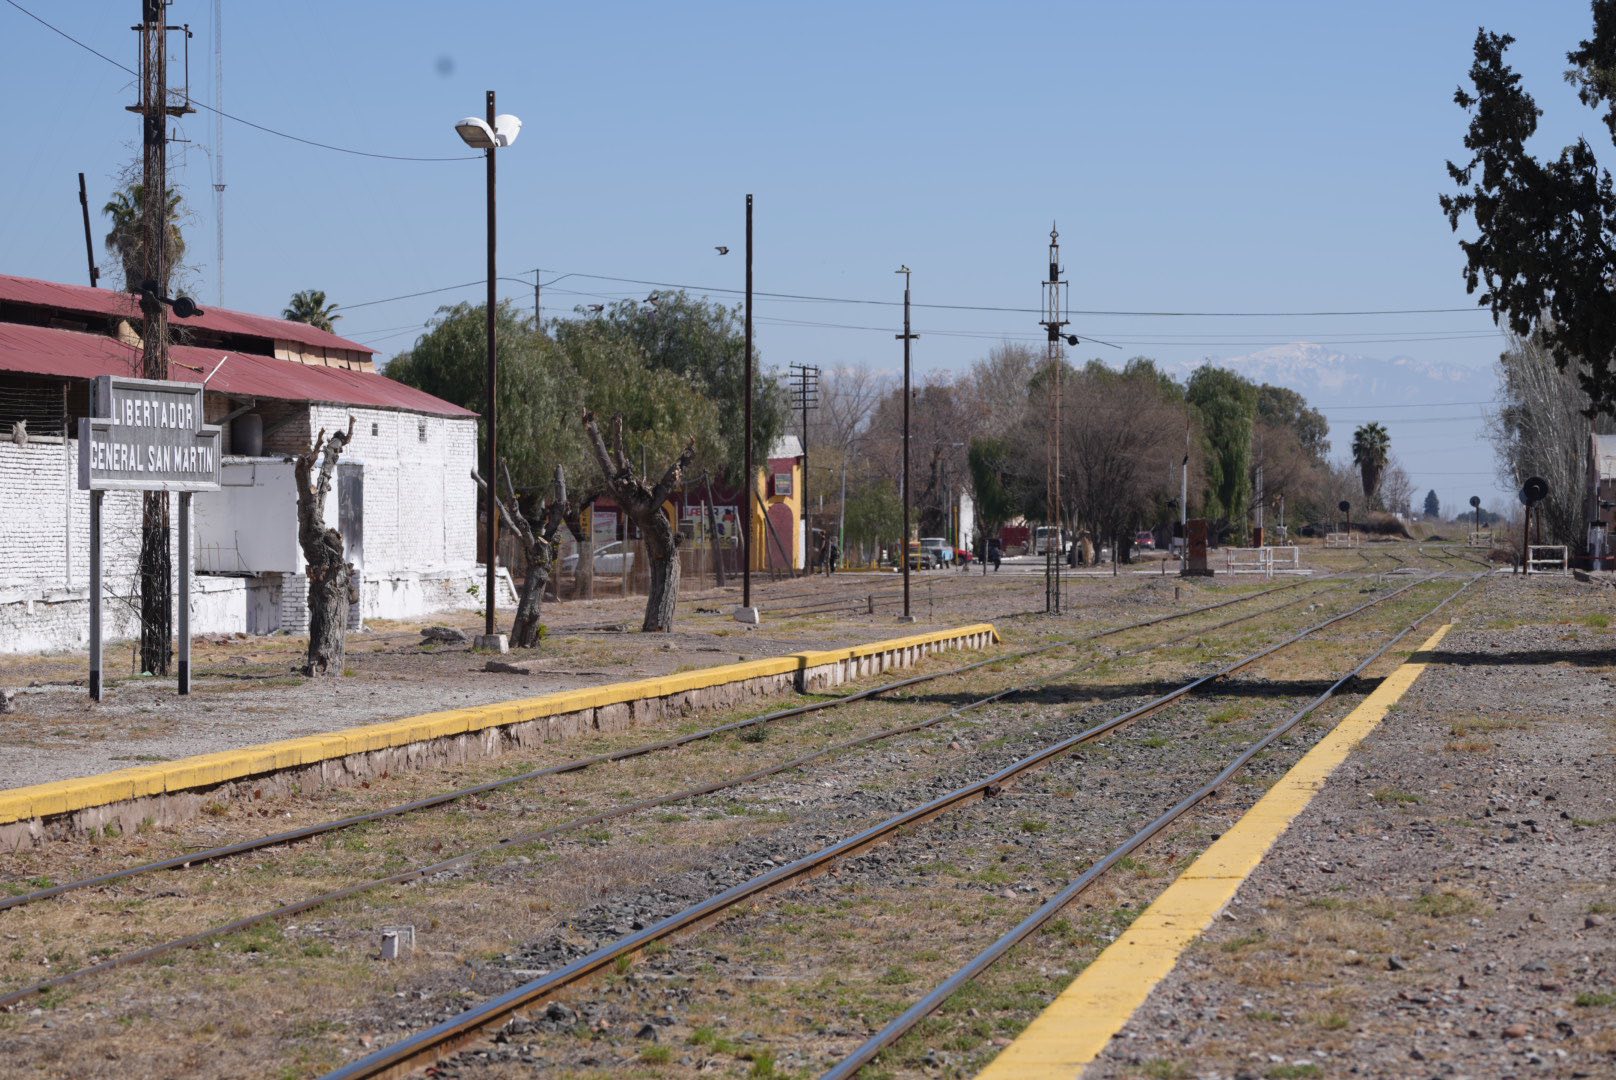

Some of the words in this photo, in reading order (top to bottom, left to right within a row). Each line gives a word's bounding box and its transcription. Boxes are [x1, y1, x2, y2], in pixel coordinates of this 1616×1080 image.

[113, 398, 193, 429] LIBERTADOR
[91, 441, 143, 471] GENERAL
[148, 445, 171, 472] SAN
[174, 446, 213, 473] MARTIN
